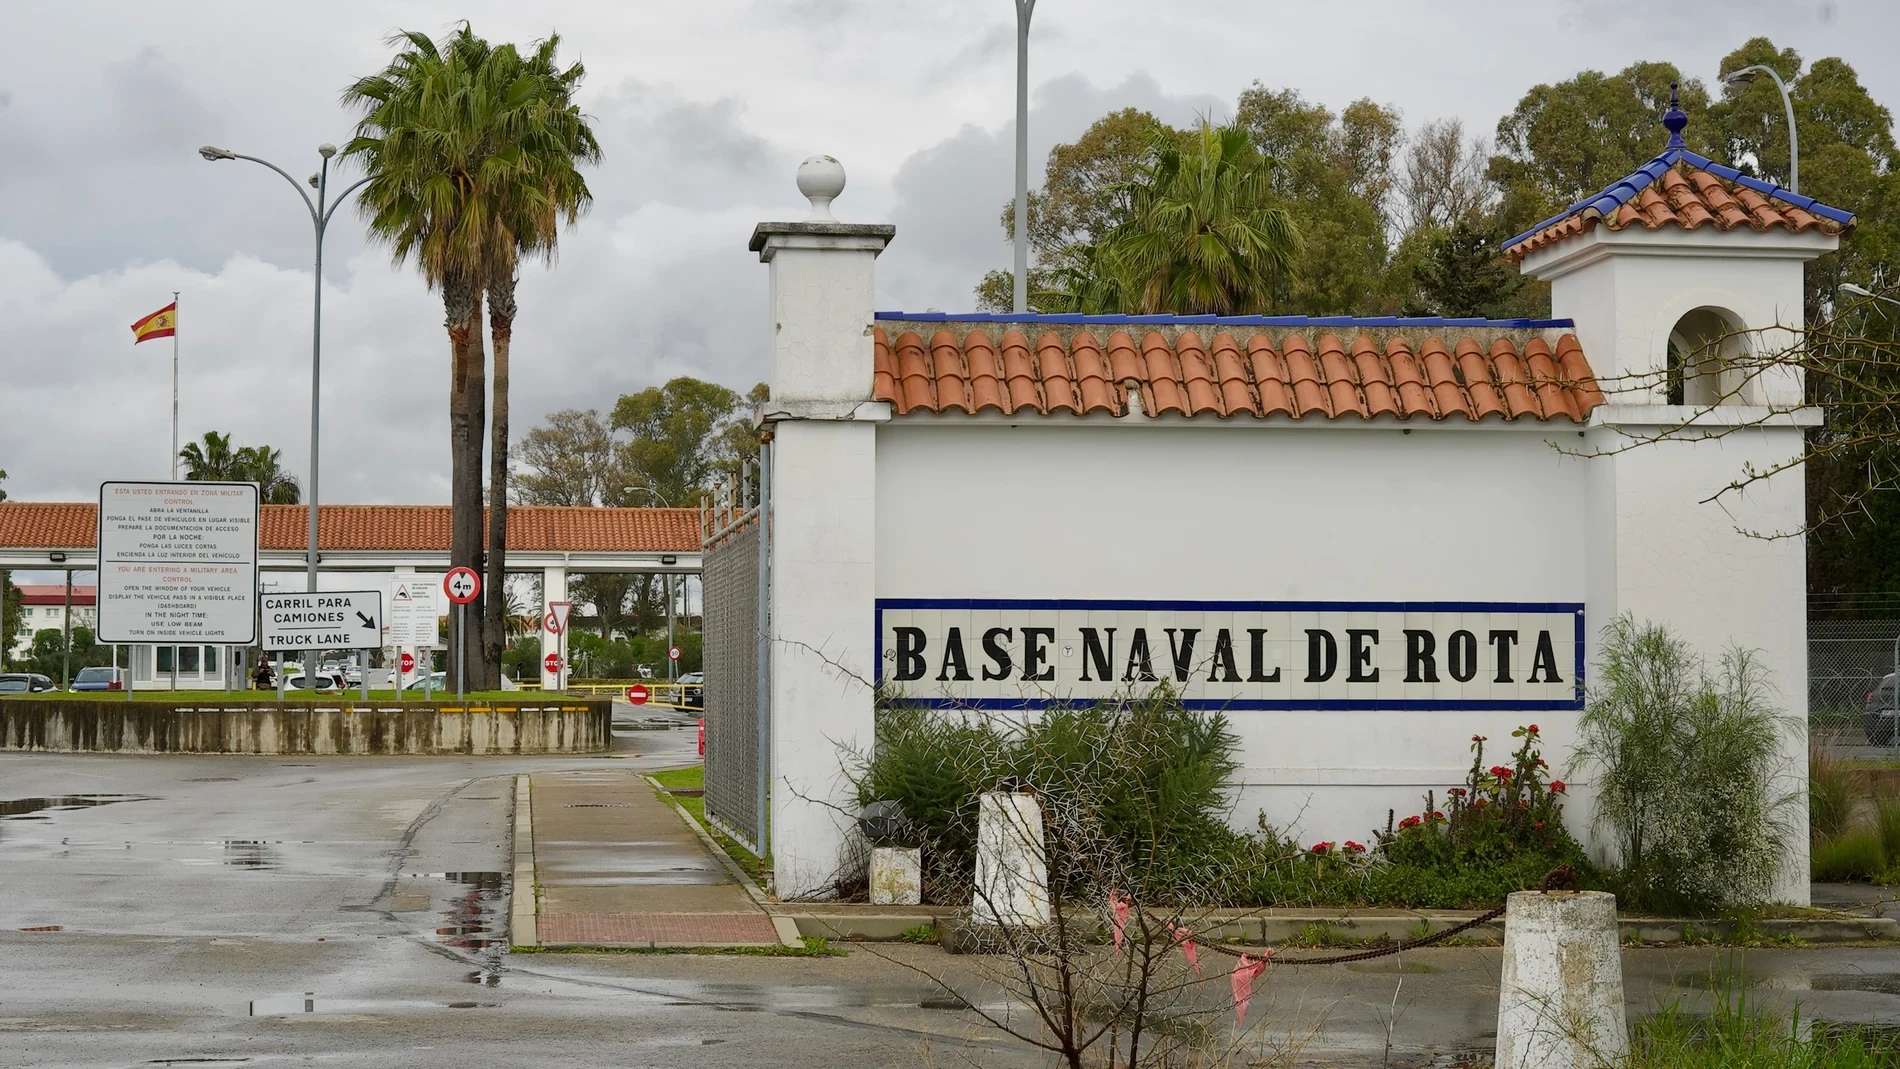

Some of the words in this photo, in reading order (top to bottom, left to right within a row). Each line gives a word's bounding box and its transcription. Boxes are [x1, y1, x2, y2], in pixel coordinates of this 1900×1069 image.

[454, 581, 462, 590] 4
[265, 599, 313, 609] CARRIL
[318, 598, 351, 608] PARA
[274, 612, 344, 623] CAMIONES
[269, 635, 312, 646] TRUCK
[317, 634, 350, 644] LANE
[892, 626, 1055, 682] BASE
[1078, 627, 1281, 683] NAVAL
[1304, 629, 1379, 683] DE
[1403, 629, 1563, 684] ROTA
